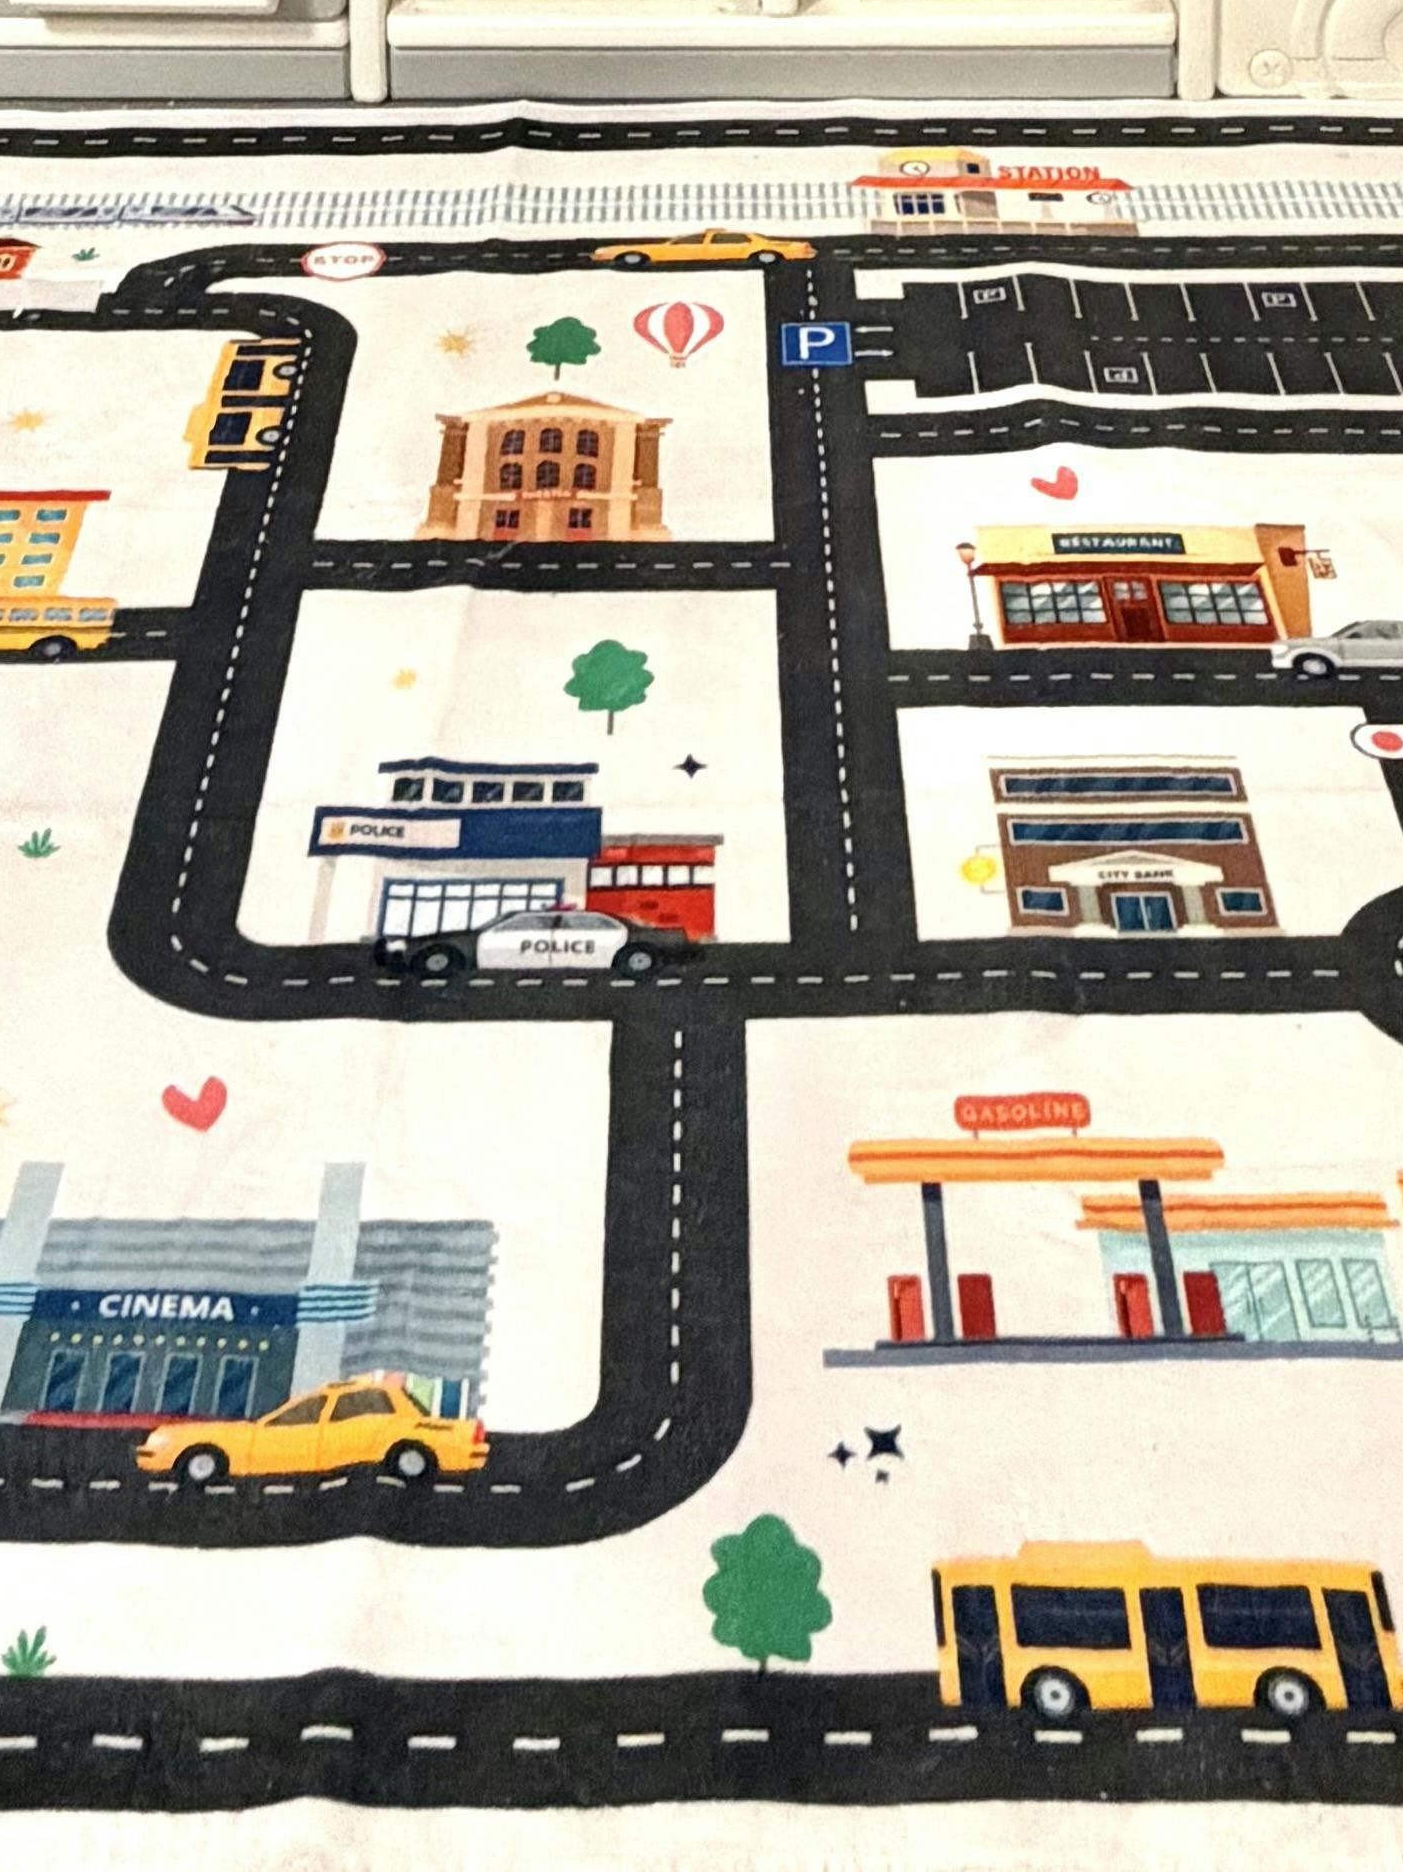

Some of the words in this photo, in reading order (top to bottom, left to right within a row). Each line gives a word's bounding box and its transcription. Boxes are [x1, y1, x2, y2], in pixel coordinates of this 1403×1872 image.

[996, 164, 1101, 181] STATION
[313, 255, 375, 266] STOP
[800, 326, 835, 360] P
[1058, 535, 1174, 550] RESTAURANT
[349, 823, 406, 839] POLICE
[1098, 870, 1129, 879] CITY
[1134, 869, 1174, 878] BANK
[519, 937, 596, 955] POLICE
[960, 1099, 1086, 1124] GASOLINE
[97, 1292, 235, 1322] CINEMA
